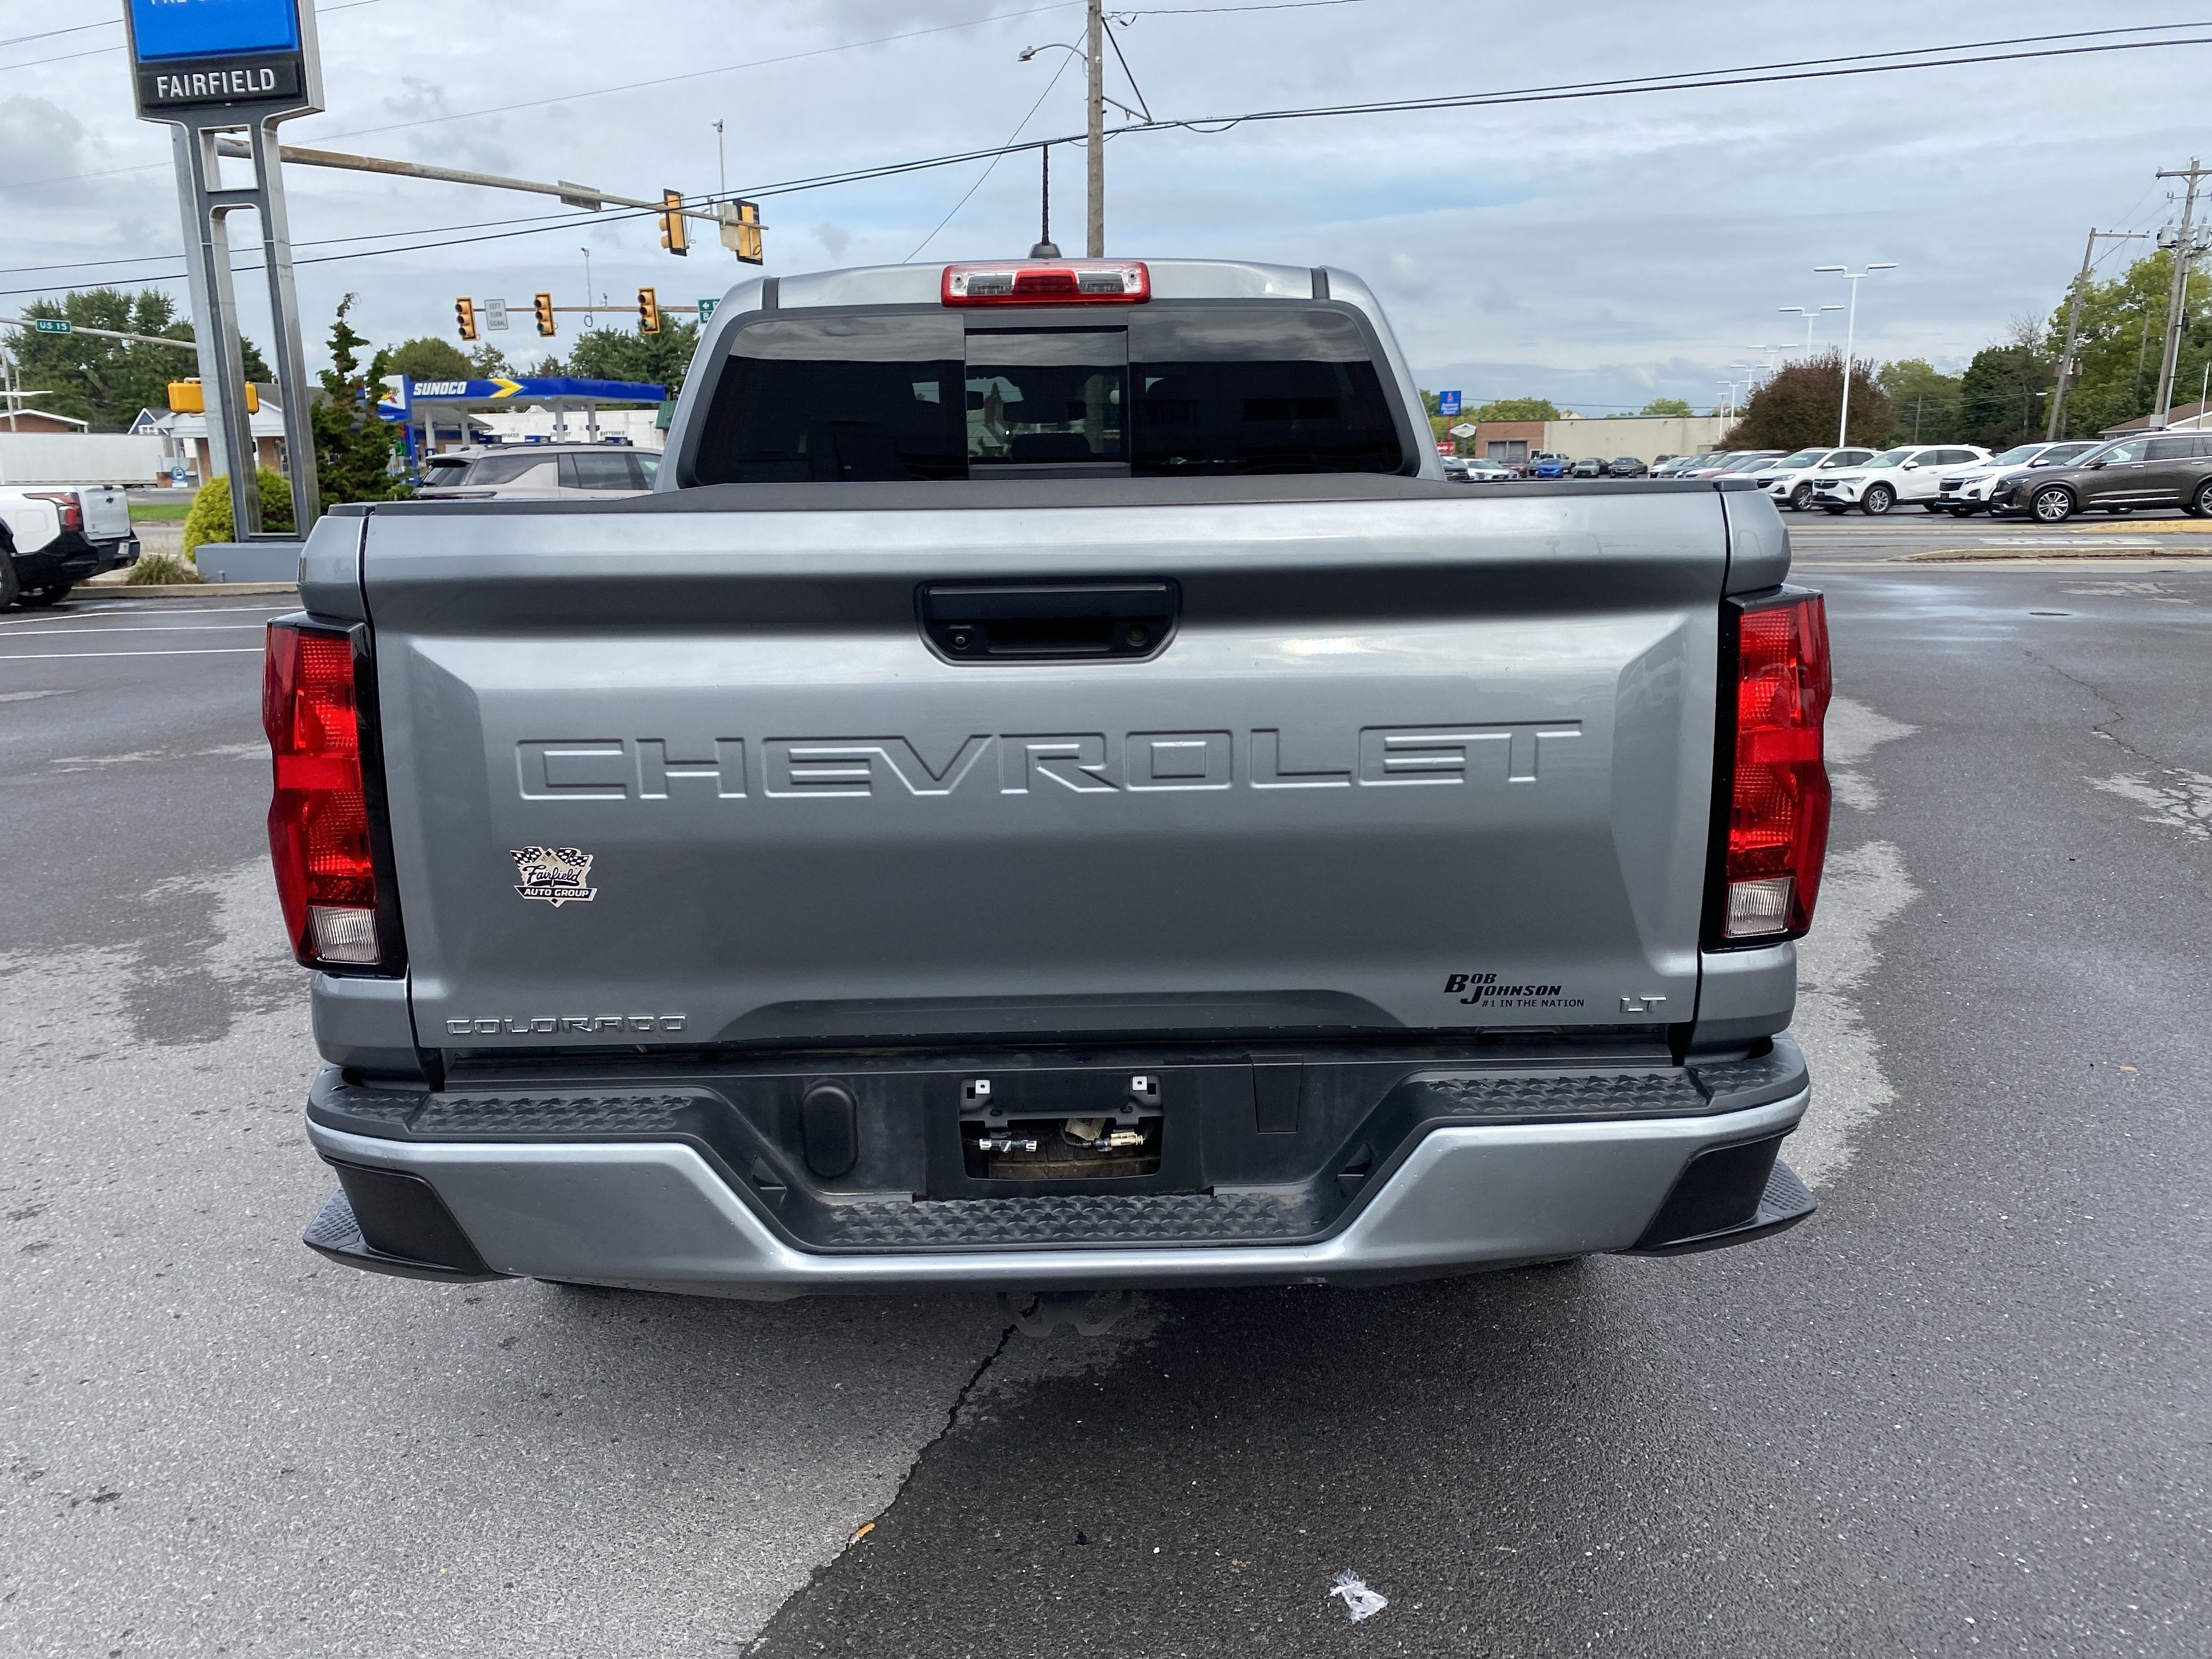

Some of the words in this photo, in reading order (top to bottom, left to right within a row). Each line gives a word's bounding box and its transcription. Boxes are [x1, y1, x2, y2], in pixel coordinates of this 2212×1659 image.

[157, 68, 275, 99] FAIRFIELD
[40, 321, 53, 329] US
[56, 322, 67, 330] 15
[413, 381, 467, 396] SUNOCO
[516, 720, 1583, 801] CHEVROLET
[522, 865, 583, 884] Fairfield
[554, 889, 589, 897] GROUP
[1443, 973, 1497, 993] BOB
[1460, 985, 1562, 1005] JOHNSON
[1541, 999, 1585, 1007] NATION
[1620, 997, 1667, 1013] LT
[445, 1014, 688, 1035] COLORADO
